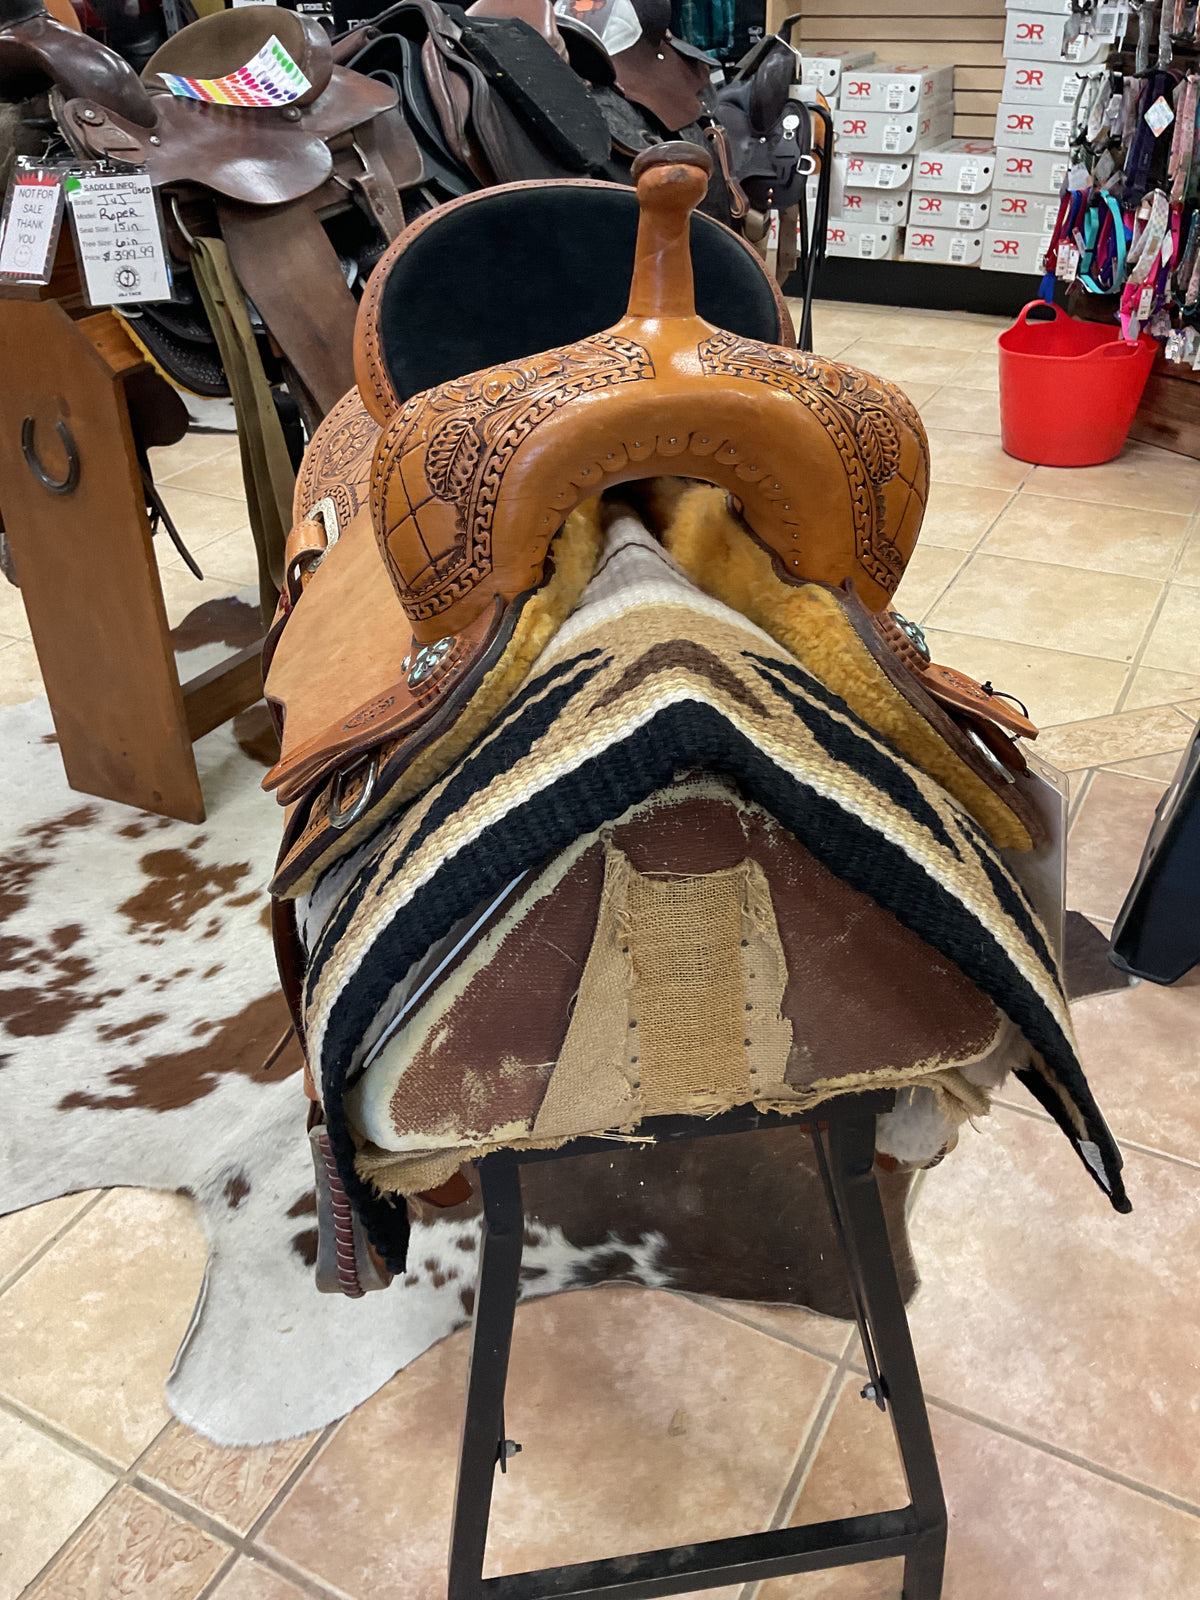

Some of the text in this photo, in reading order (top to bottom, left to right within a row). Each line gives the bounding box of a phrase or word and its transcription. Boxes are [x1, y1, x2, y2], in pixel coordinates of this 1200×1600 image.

[84, 183, 115, 192] SADDLE
[19, 189, 54, 199] NOT FOR
[23, 204, 44, 214] SALE
[17, 218, 44, 230] THANK
[18, 234, 36, 245] YOU
